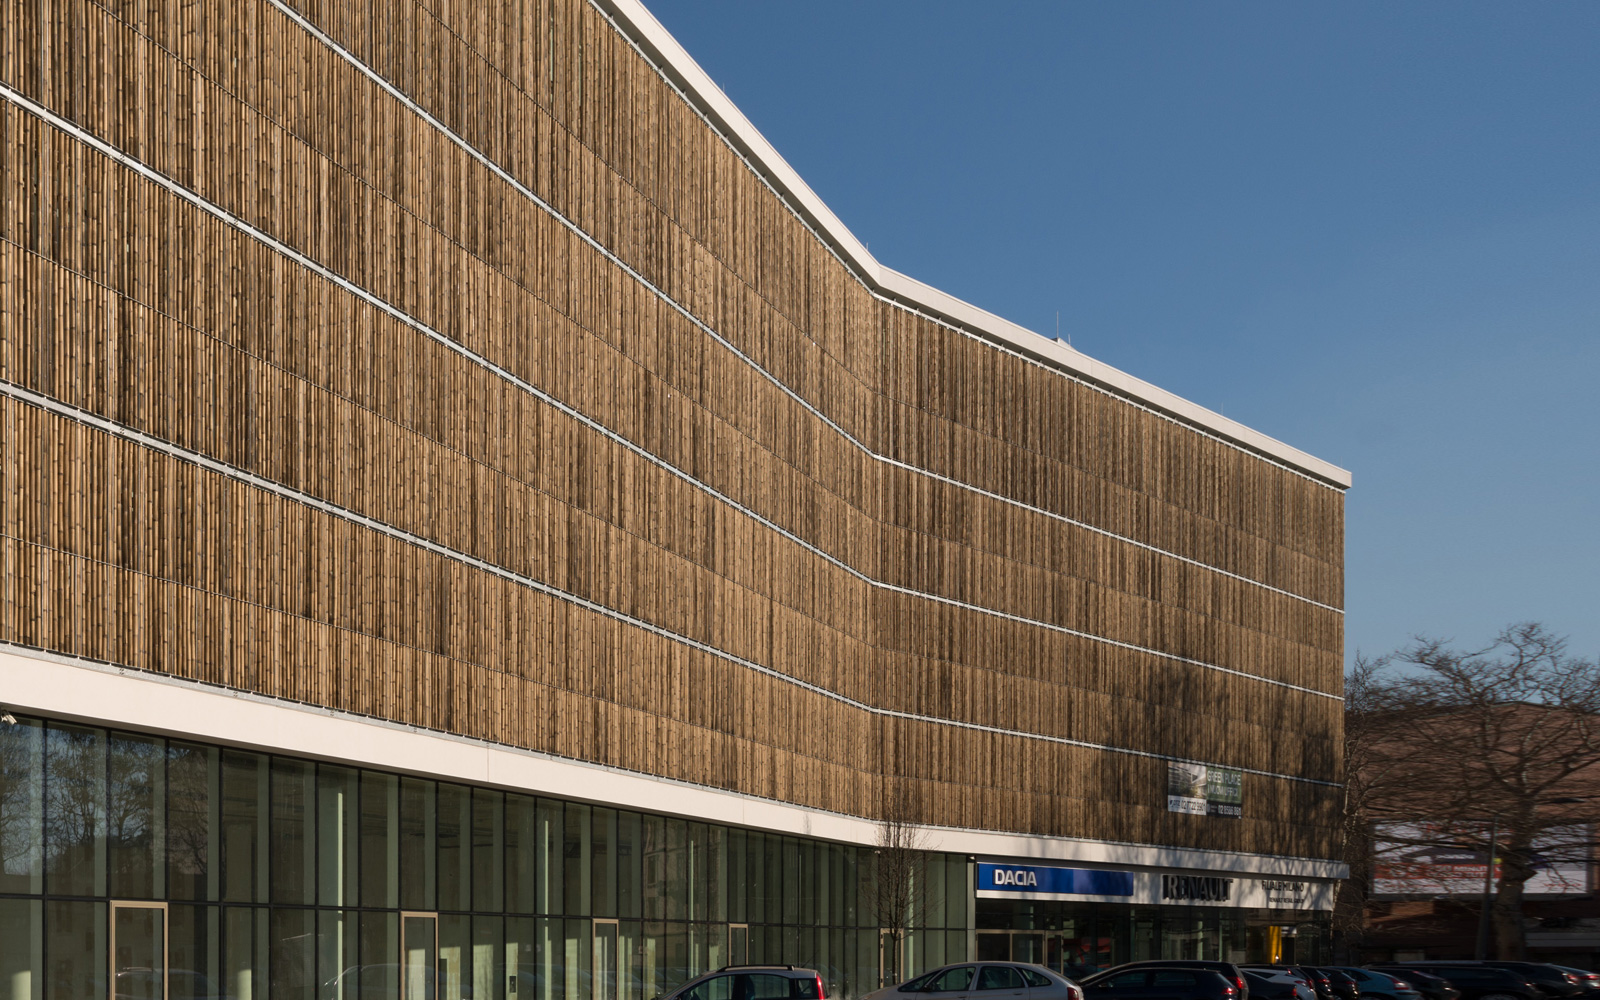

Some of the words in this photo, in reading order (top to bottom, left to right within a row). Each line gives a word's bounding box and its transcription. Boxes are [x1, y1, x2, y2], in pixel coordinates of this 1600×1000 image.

[1207, 770, 1224, 783] GREEN
[1225, 773, 1241, 786] PLACE
[994, 869, 1037, 886] DACIA
[1163, 874, 1233, 902] RENAULT
[1261, 880, 1281, 891] FILIALE
[1282, 881, 1304, 892] MILANO
